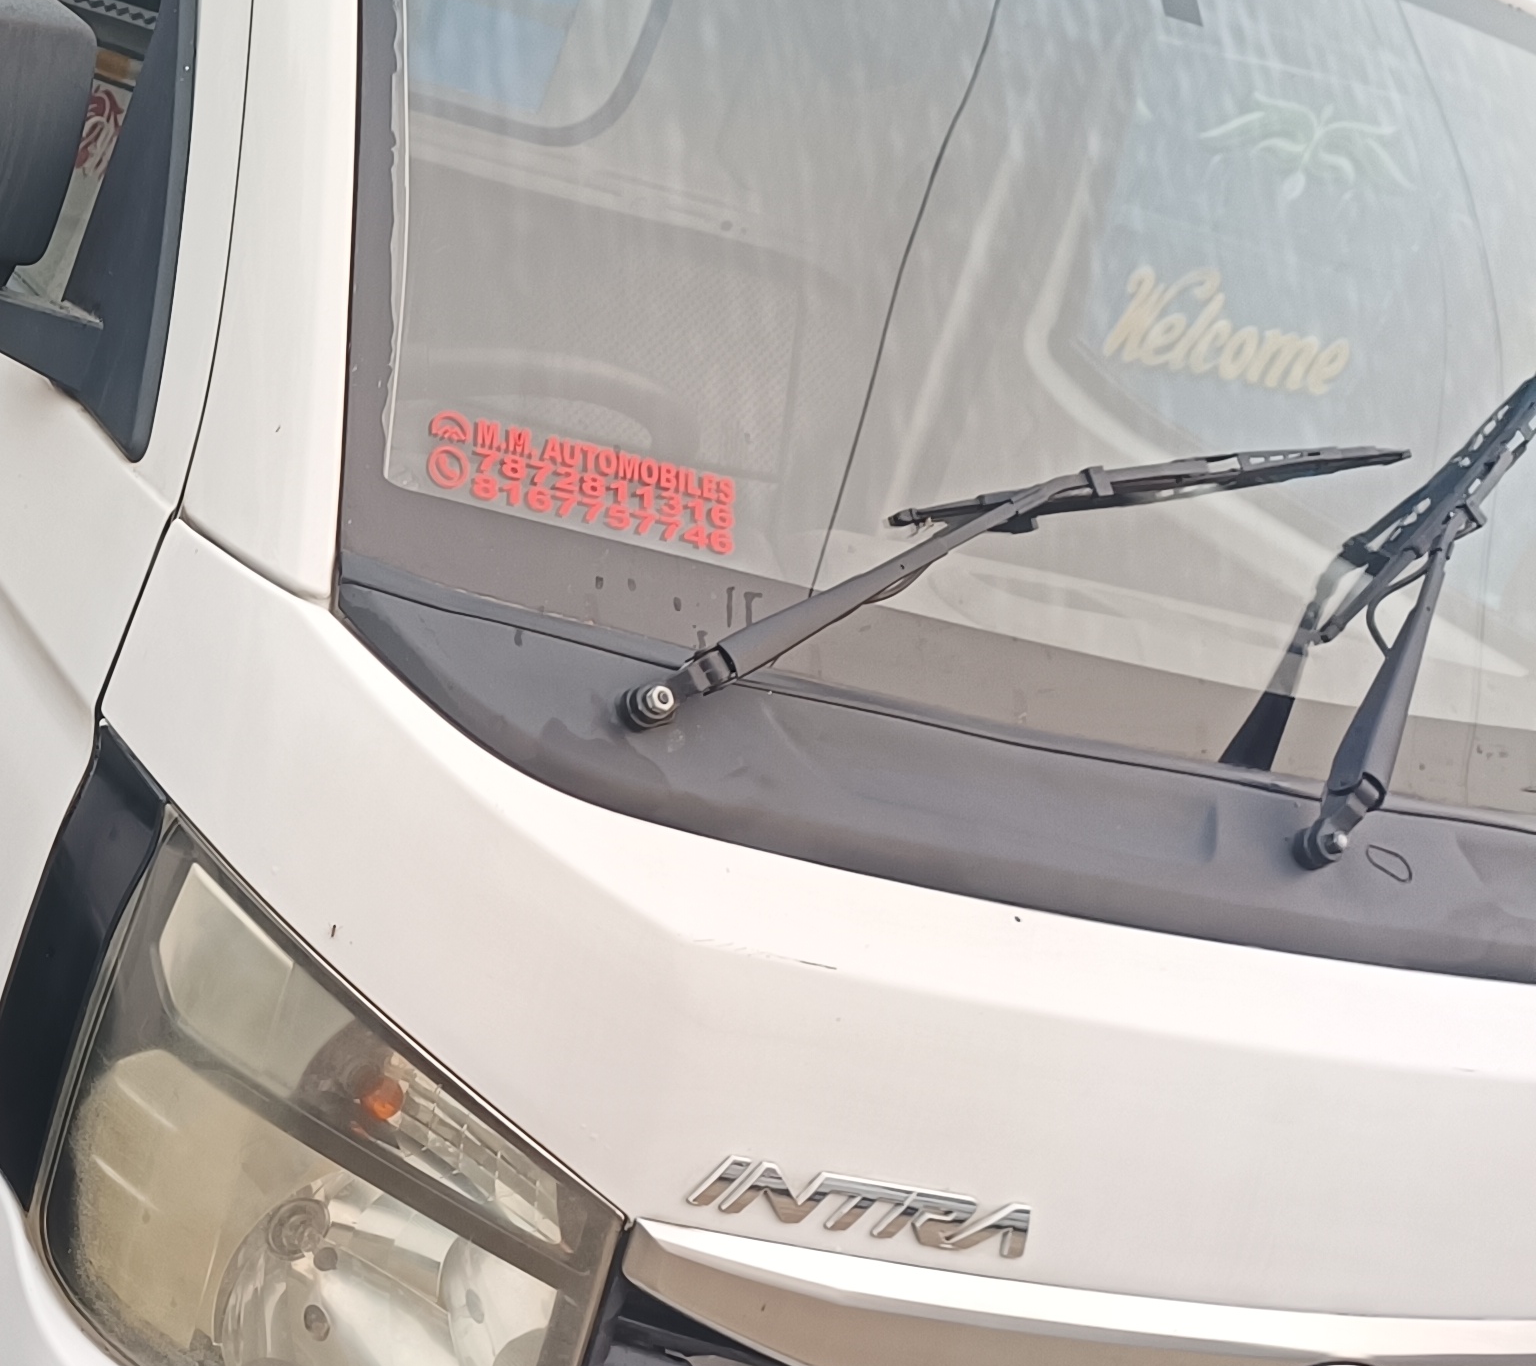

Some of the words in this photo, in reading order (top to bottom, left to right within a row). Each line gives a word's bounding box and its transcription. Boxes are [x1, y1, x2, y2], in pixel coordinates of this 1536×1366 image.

[1102, 264, 1352, 396] Welcome
[472, 448, 735, 531] 7872811316
[473, 418, 537, 459] M.M.
[543, 435, 736, 507] AUTOMOBILES
[470, 473, 735, 555] 8167757746
[685, 1154, 1032, 1259] INTRA
